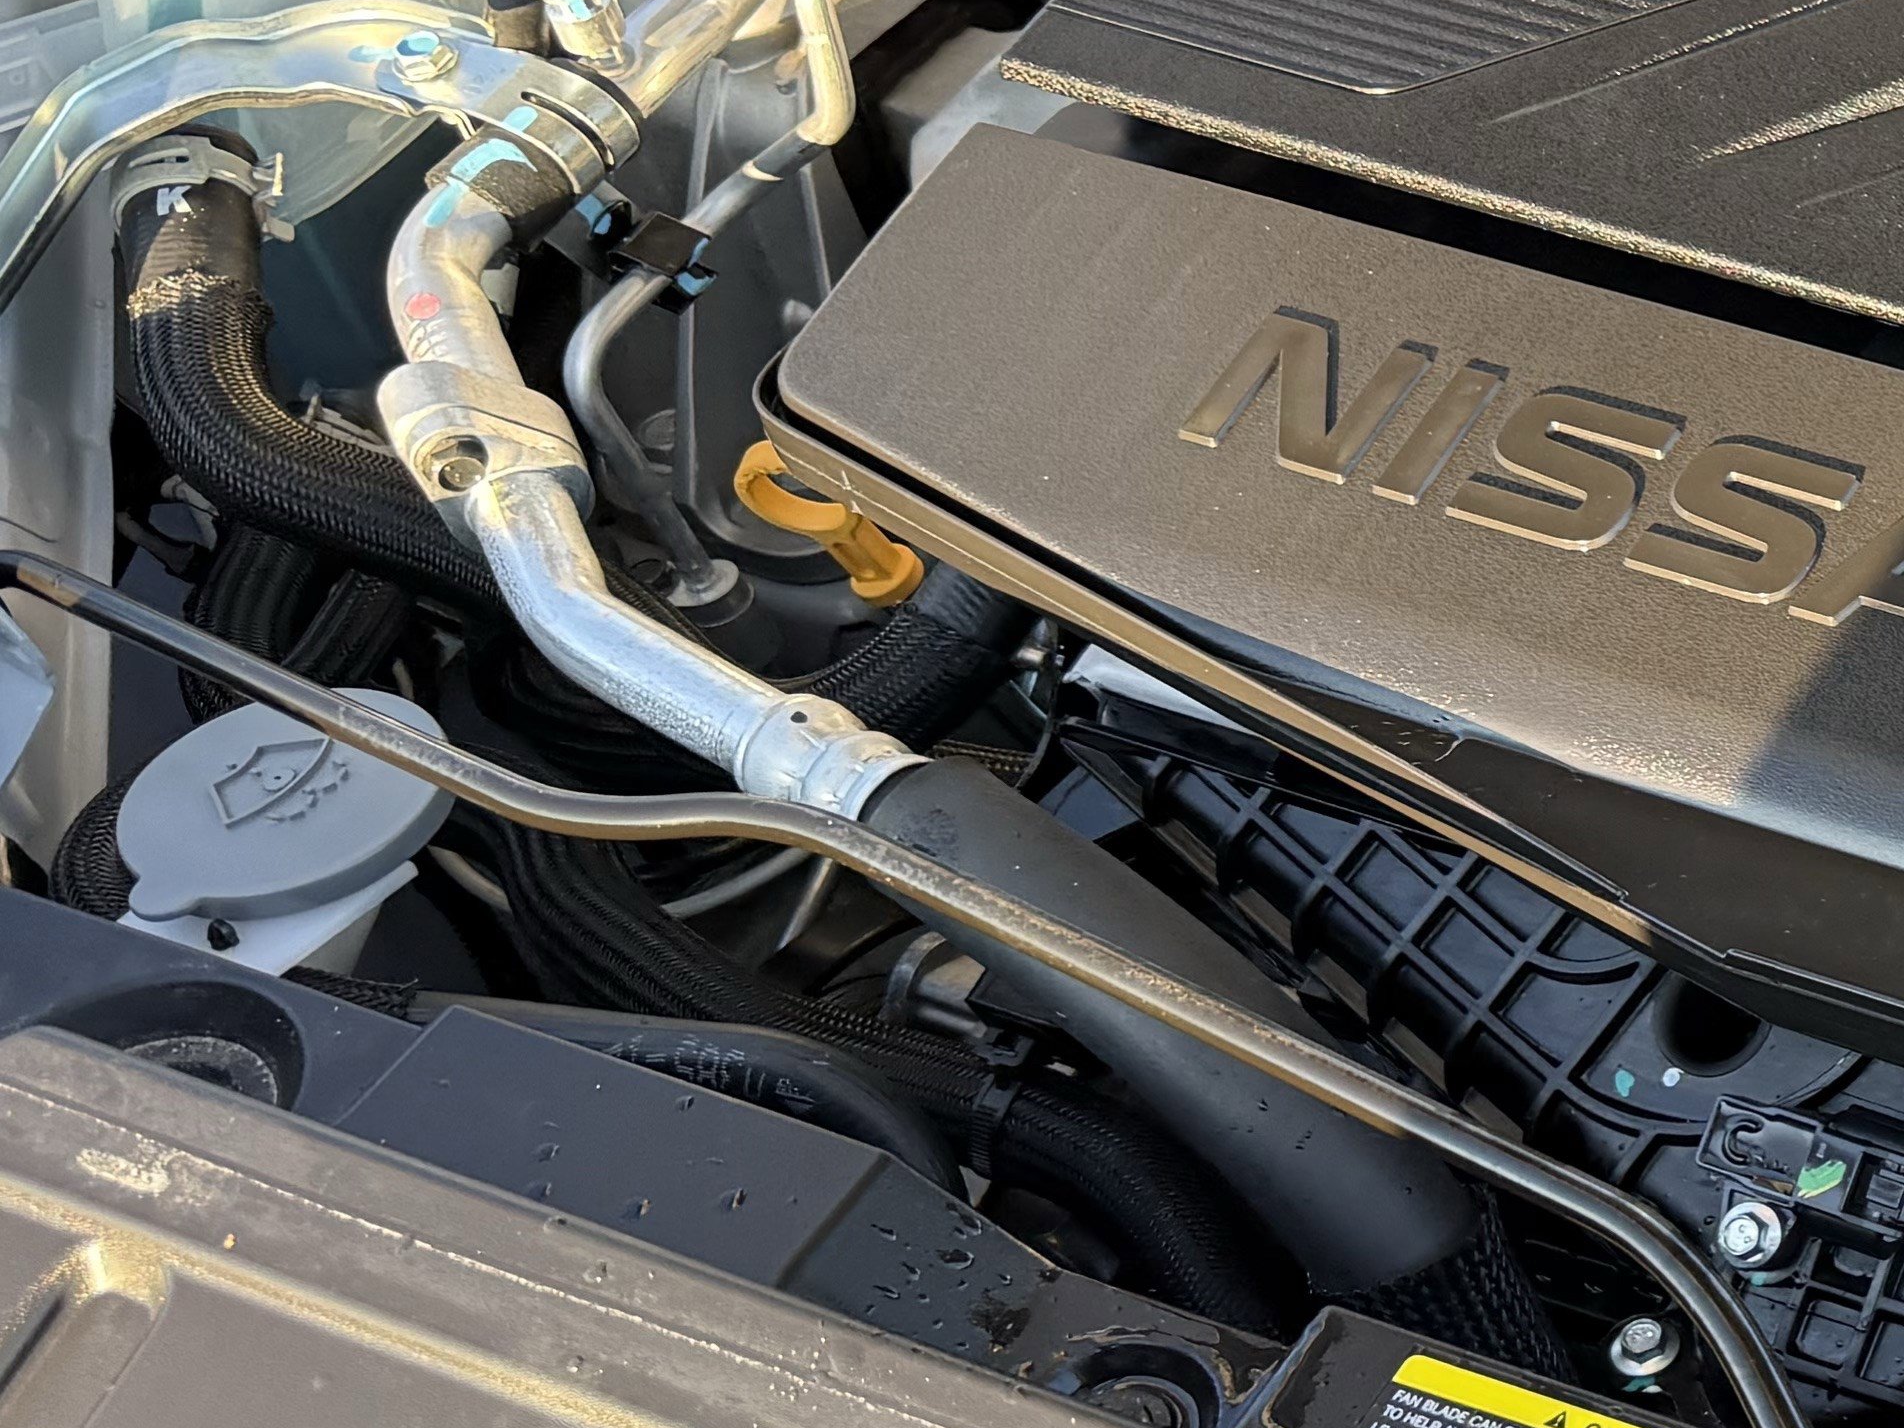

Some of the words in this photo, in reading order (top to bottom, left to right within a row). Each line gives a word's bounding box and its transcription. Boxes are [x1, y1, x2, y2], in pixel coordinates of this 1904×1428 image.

[156, 185, 192, 216] K
[1380, 1404, 1405, 1421] TO
[1390, 1388, 1424, 1408] FAN
[1419, 1398, 1471, 1423] BLADE
